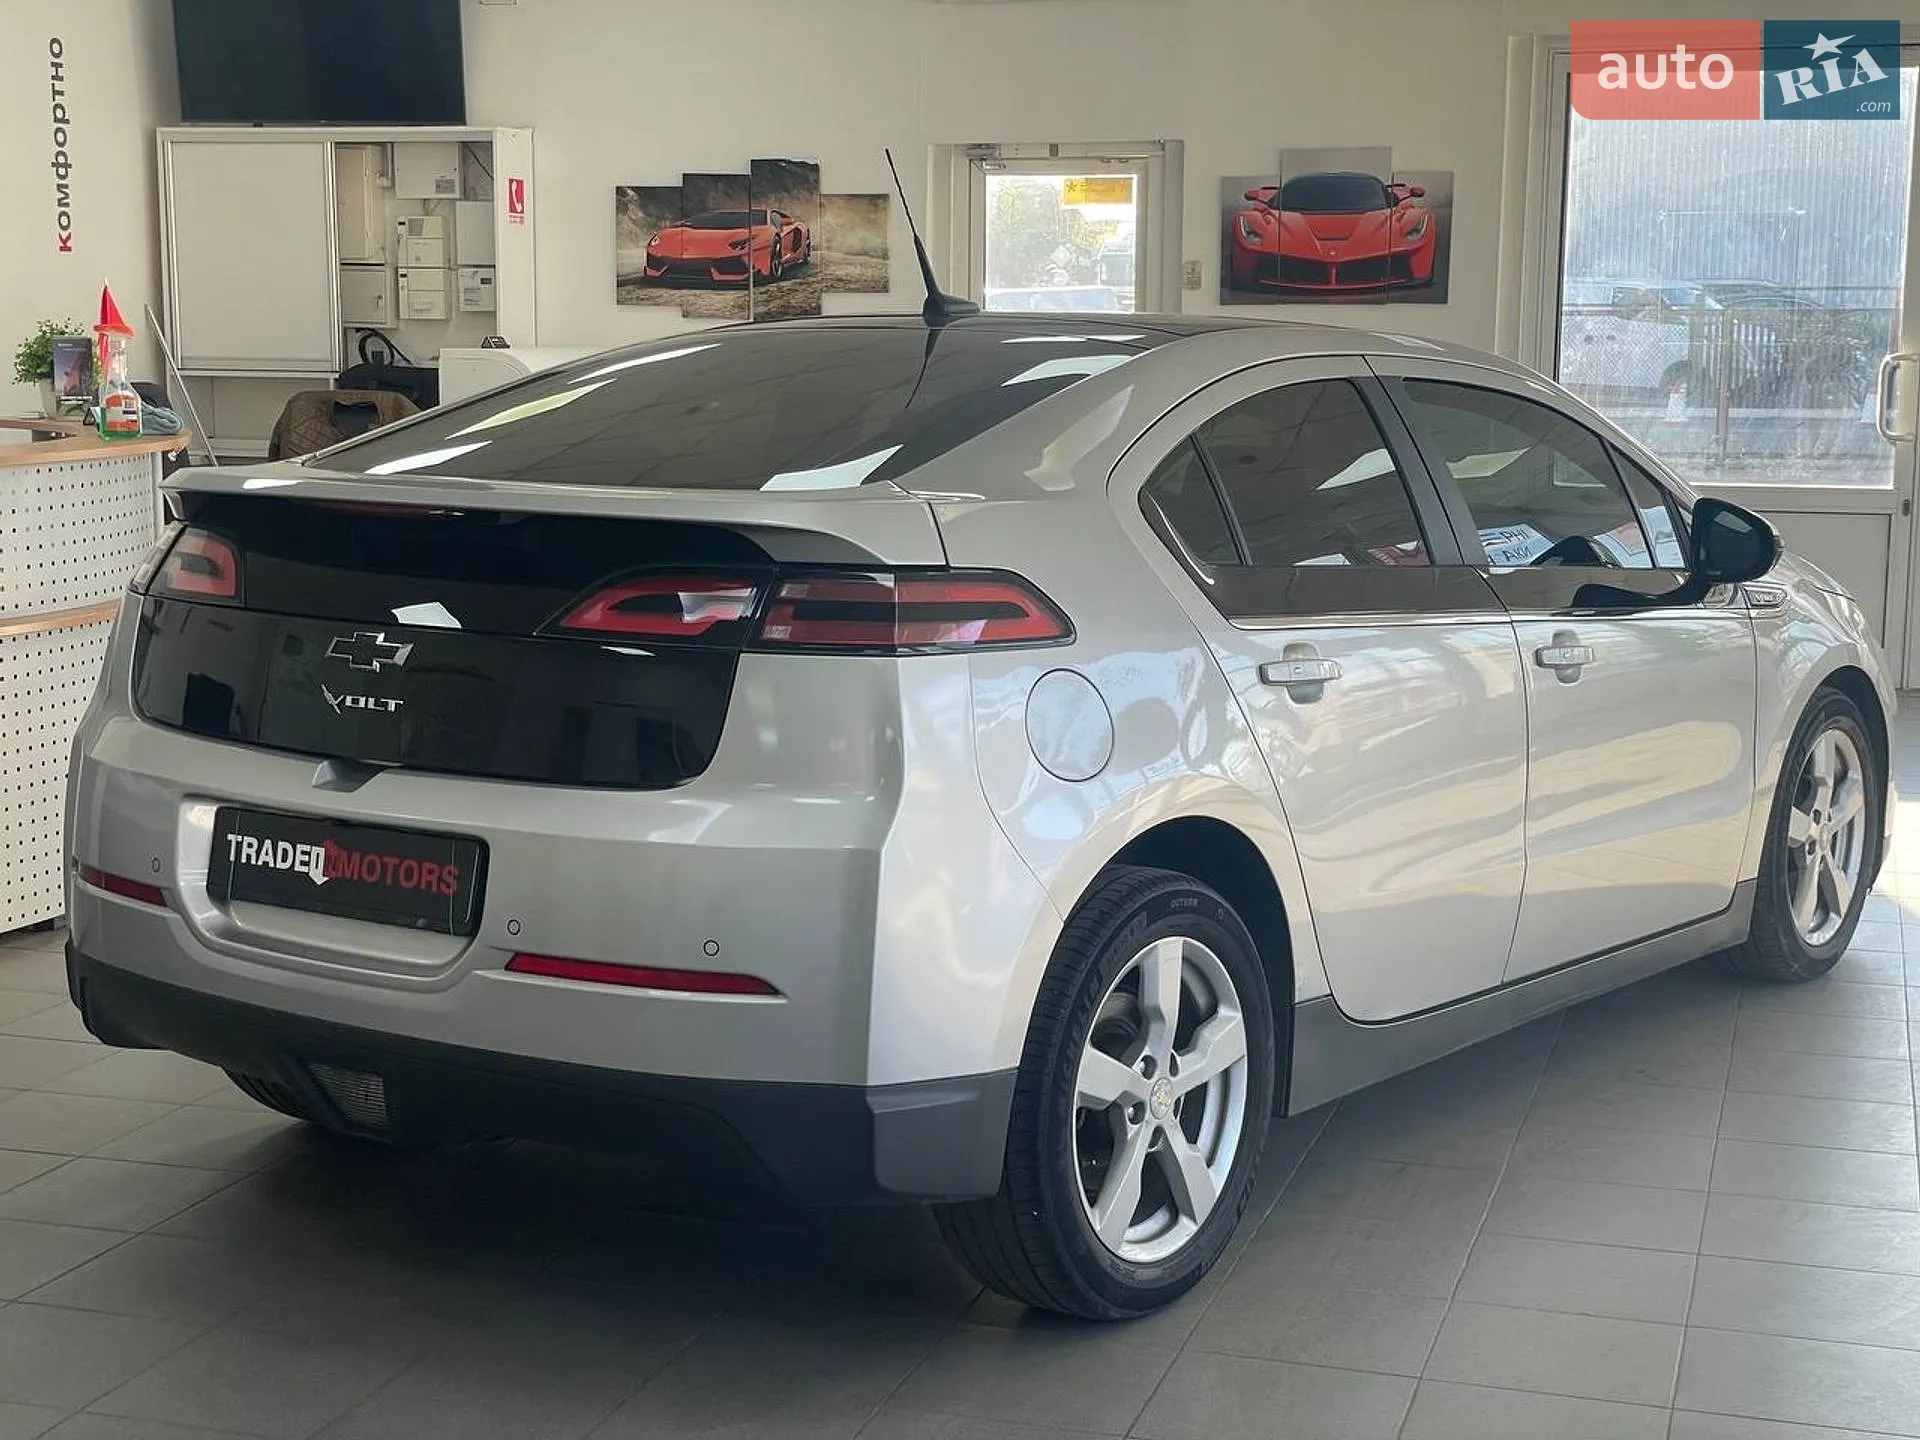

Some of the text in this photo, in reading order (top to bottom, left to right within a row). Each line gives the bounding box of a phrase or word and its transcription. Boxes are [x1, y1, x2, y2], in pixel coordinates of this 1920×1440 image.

[49, 37, 73, 252] комфортно
[321, 684, 404, 715] VOLT
[336, 849, 459, 895] MOTORS
